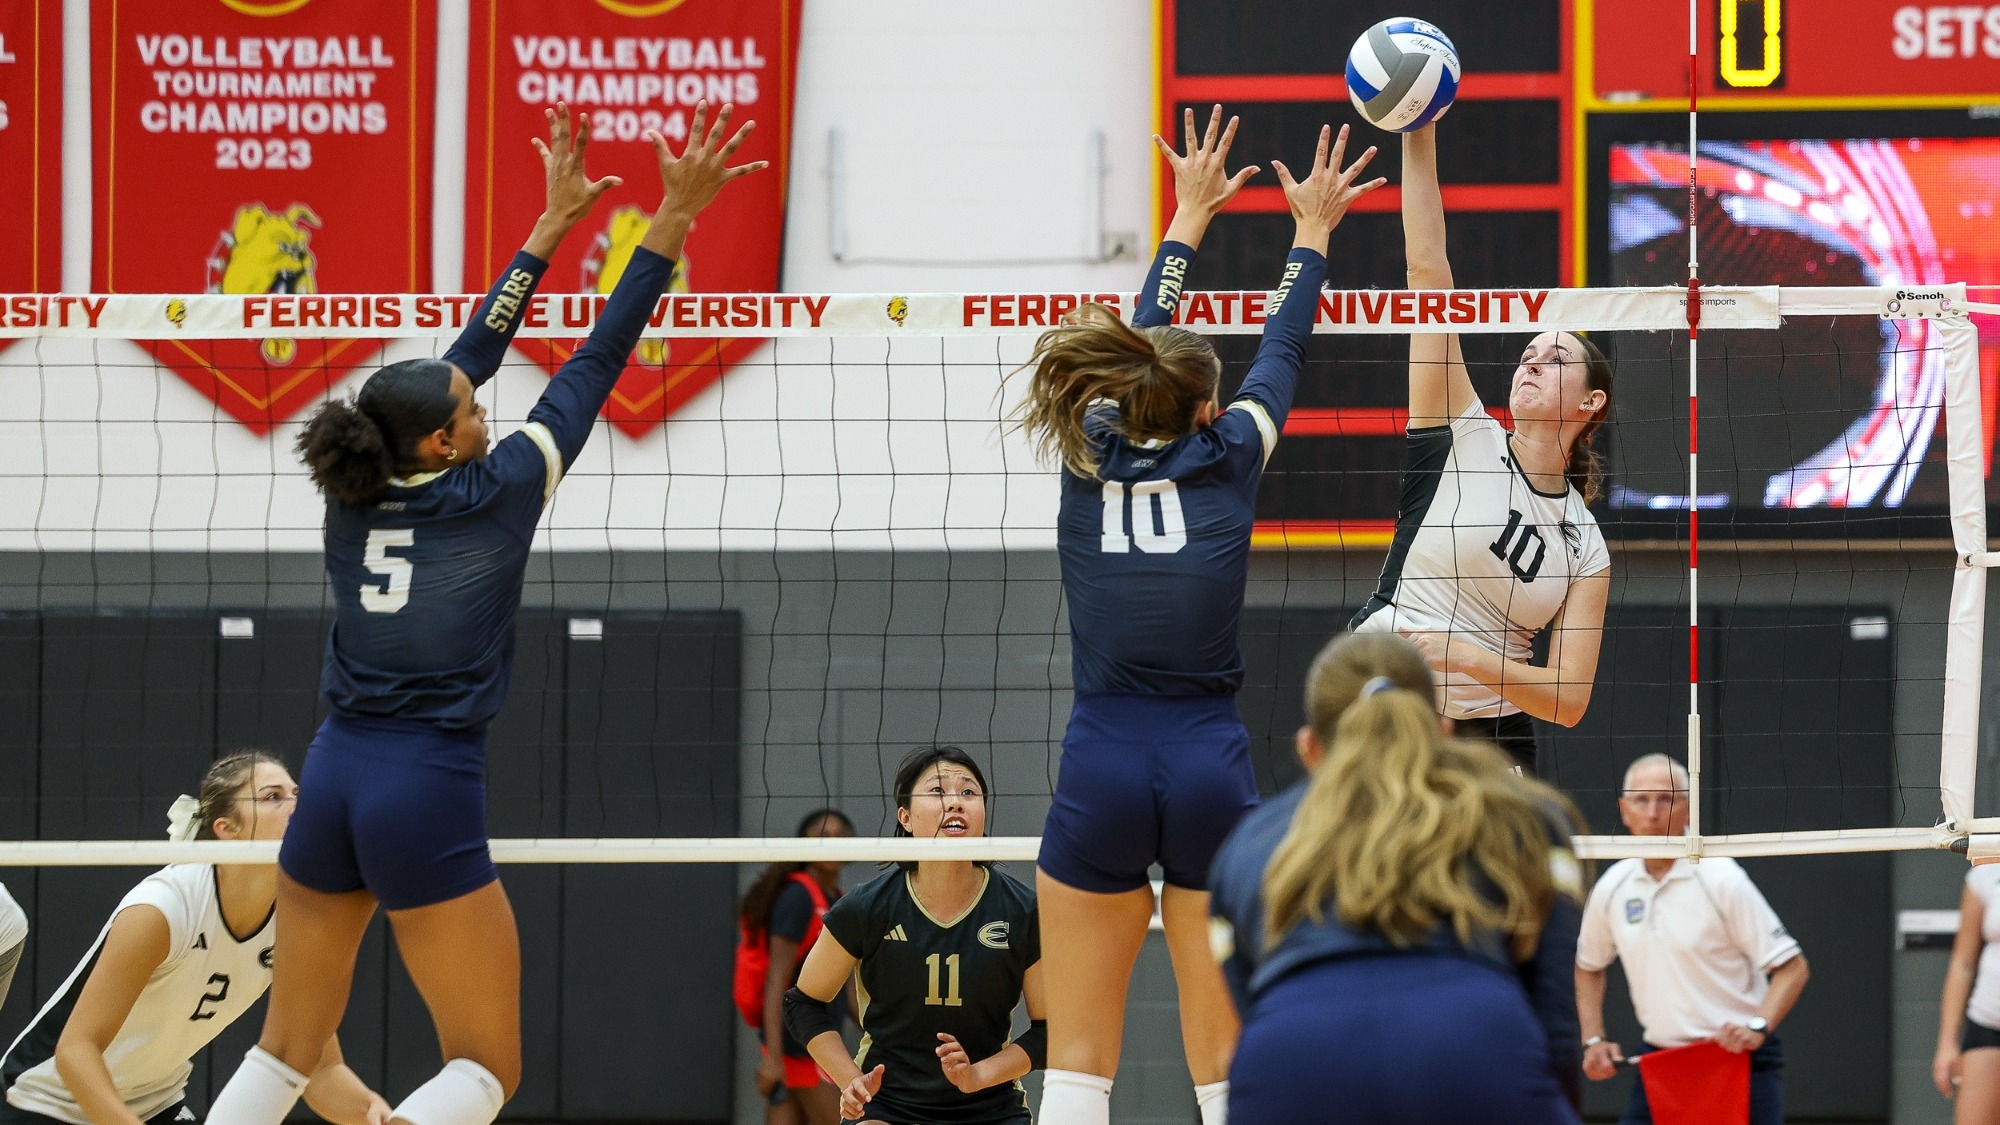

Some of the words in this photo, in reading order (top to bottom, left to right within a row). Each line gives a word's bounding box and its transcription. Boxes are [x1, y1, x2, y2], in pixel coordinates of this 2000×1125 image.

[1891, 5, 2000, 60] SETS
[136, 34, 394, 68] VOLLEYBALL
[513, 36, 765, 69] VOLLEYBALL
[153, 71, 376, 98] TOURNAMENT
[518, 73, 759, 106] CHAMPIONS
[140, 102, 388, 134] CHAMPIONS
[591, 110, 686, 142] 2024
[215, 138, 312, 170] 2023
[484, 267, 535, 334] STARS
[1156, 255, 1188, 316] STARS
[1907, 292, 1944, 300] Senoh
[0, 297, 108, 328] SITY
[243, 297, 401, 328] FERRIS
[415, 296, 549, 328] STE
[562, 296, 831, 328] UVERSITY
[1313, 290, 1549, 324] NIVERSITY
[1100, 478, 1188, 554] 10
[1489, 509, 1547, 583] 10
[359, 528, 415, 614] 5
[189, 972, 230, 1022] 2
[924, 953, 963, 1007] 11
